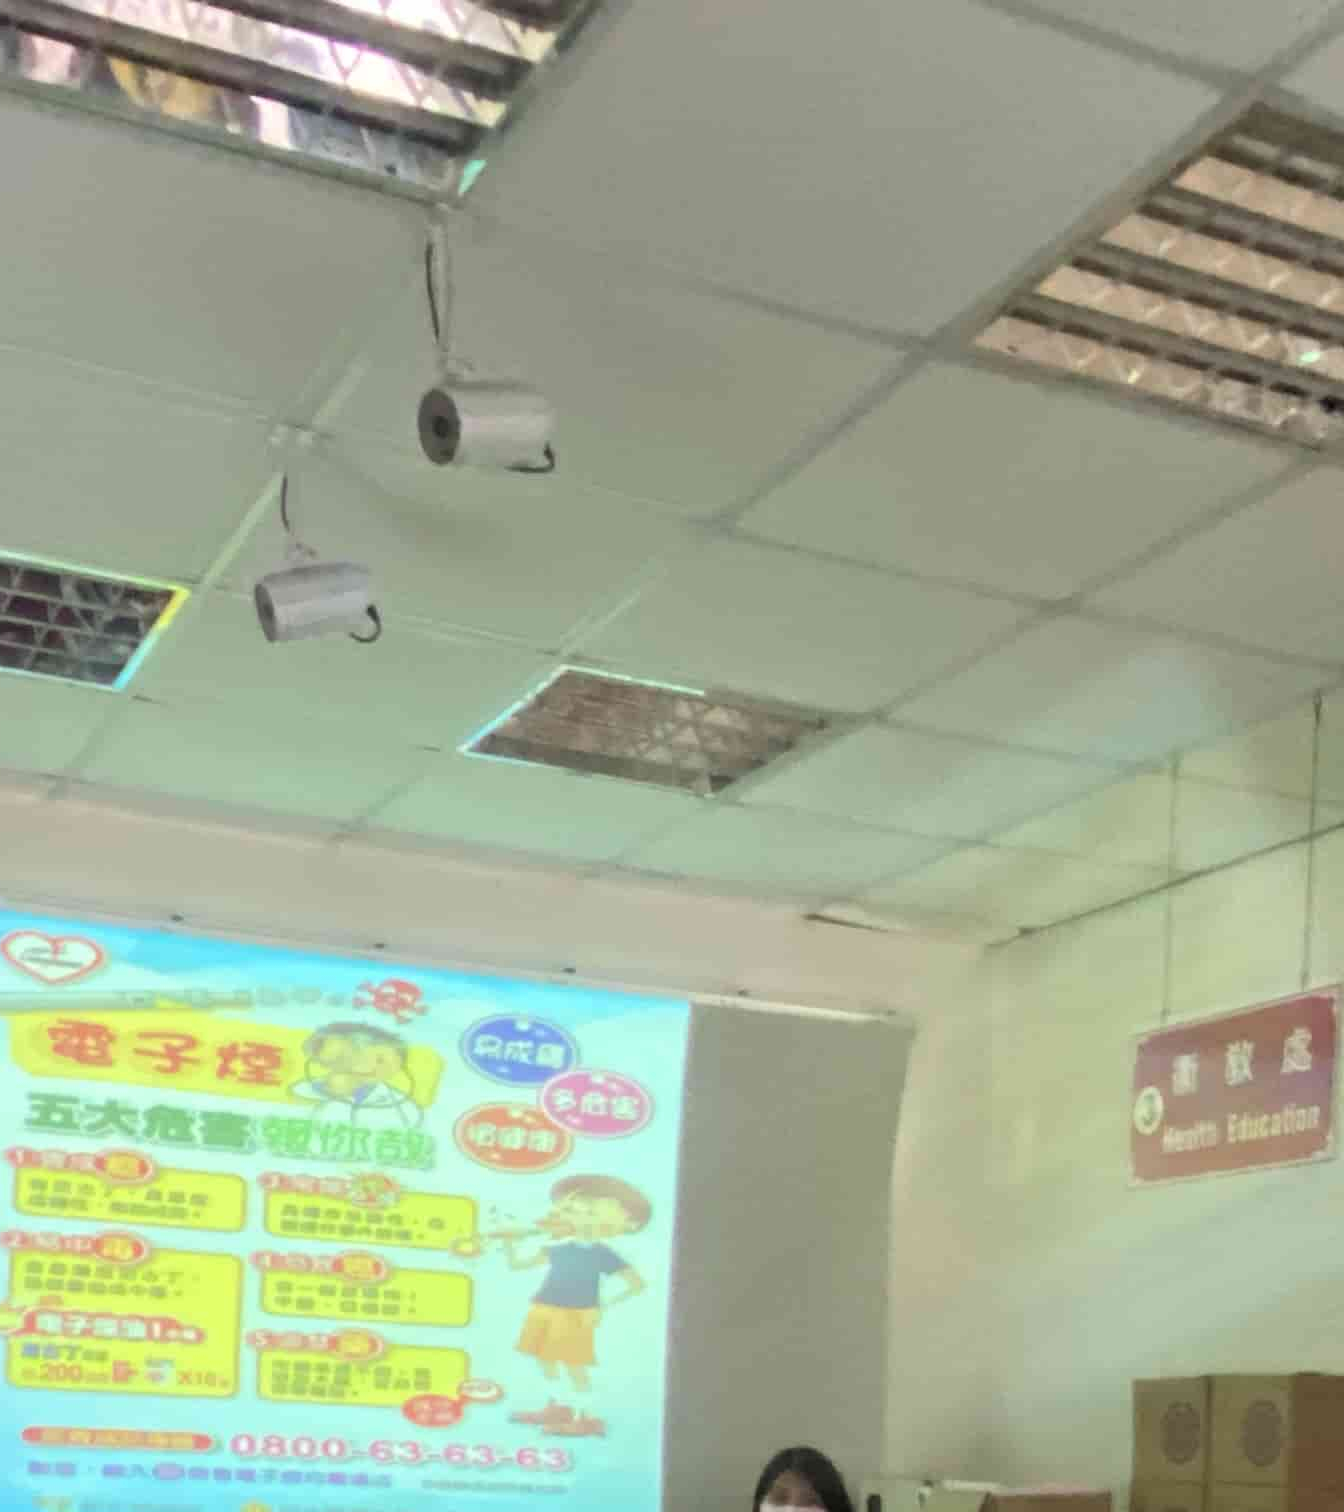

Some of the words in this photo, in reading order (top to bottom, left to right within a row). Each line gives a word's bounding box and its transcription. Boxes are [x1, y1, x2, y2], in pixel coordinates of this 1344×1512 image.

[47, 1018, 285, 1087] 電子煙
[1227, 1103, 1321, 1144] Education
[229, 1433, 571, 1472] 0800-63-63-63
